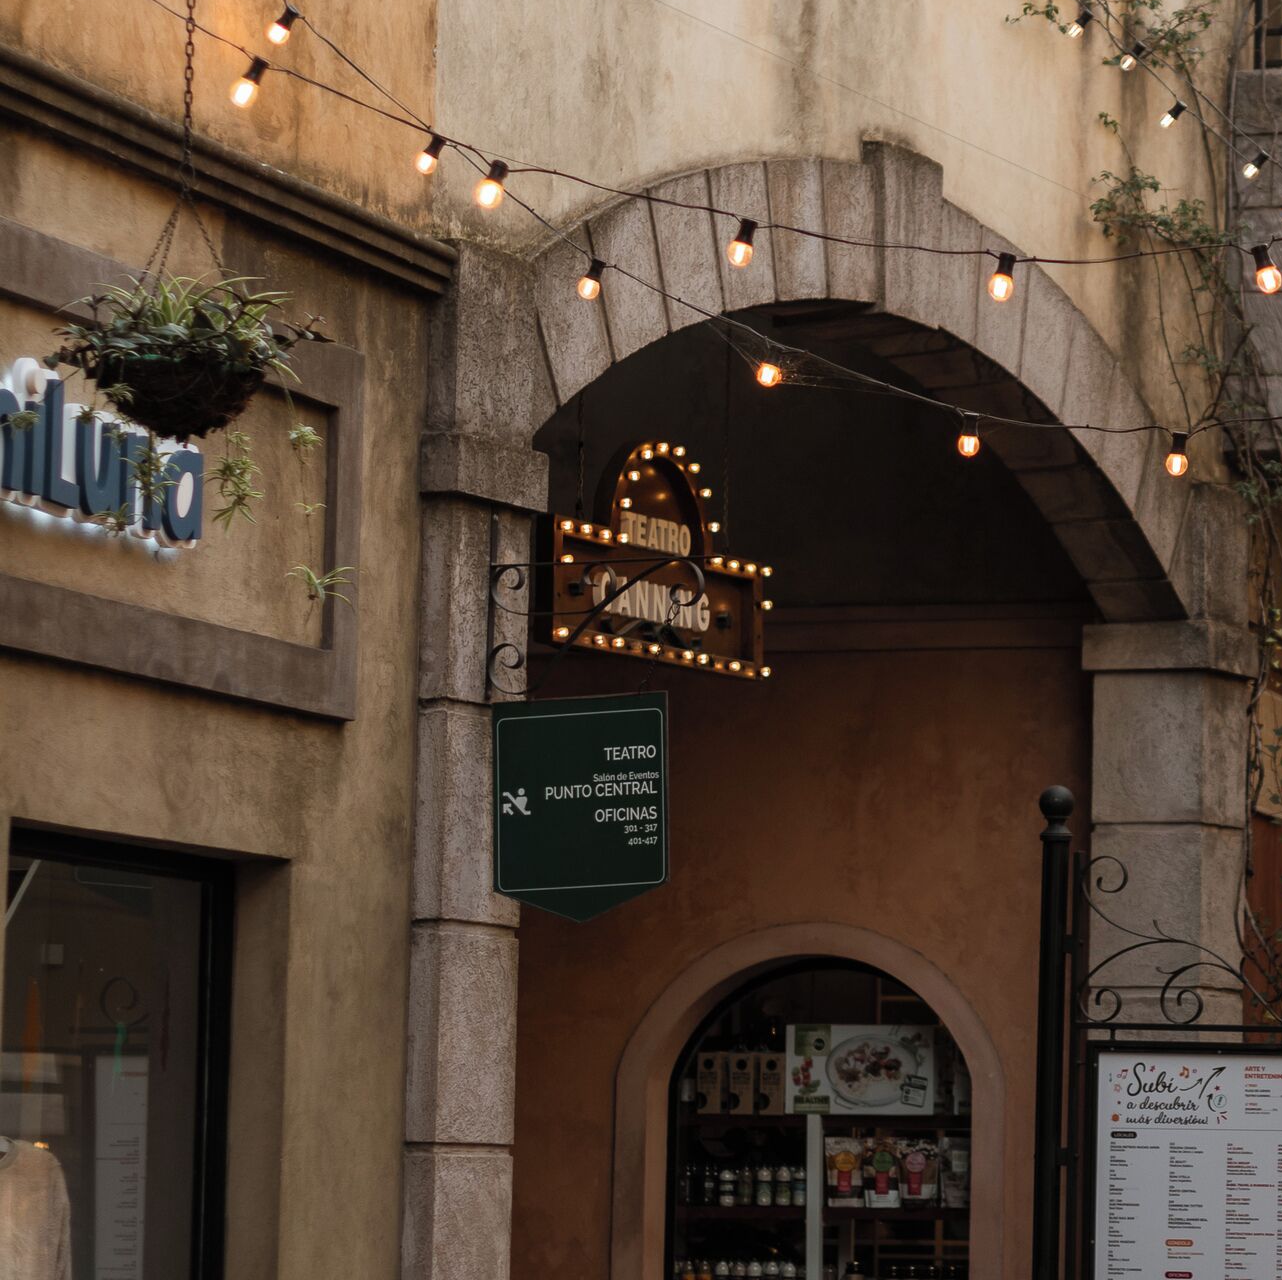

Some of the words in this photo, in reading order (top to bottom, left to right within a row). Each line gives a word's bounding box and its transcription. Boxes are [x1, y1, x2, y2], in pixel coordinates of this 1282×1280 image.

[620, 511, 692, 557] TEATRO
[603, 744, 657, 761] TEATRO
[592, 772, 616, 783] Salón
[616, 772, 628, 782] de
[628, 770, 660, 781] Eventos
[545, 784, 592, 800] PUNTO
[594, 780, 658, 797] CENTRAL
[594, 806, 658, 824] OFICINAS
[624, 824, 638, 834] 301
[644, 823, 658, 833] 317
[627, 836, 658, 846] 401-417
[1126, 1101, 1137, 1110] a
[1139, 1096, 1200, 1112] descubrir
[1125, 1114, 1152, 1125] más
